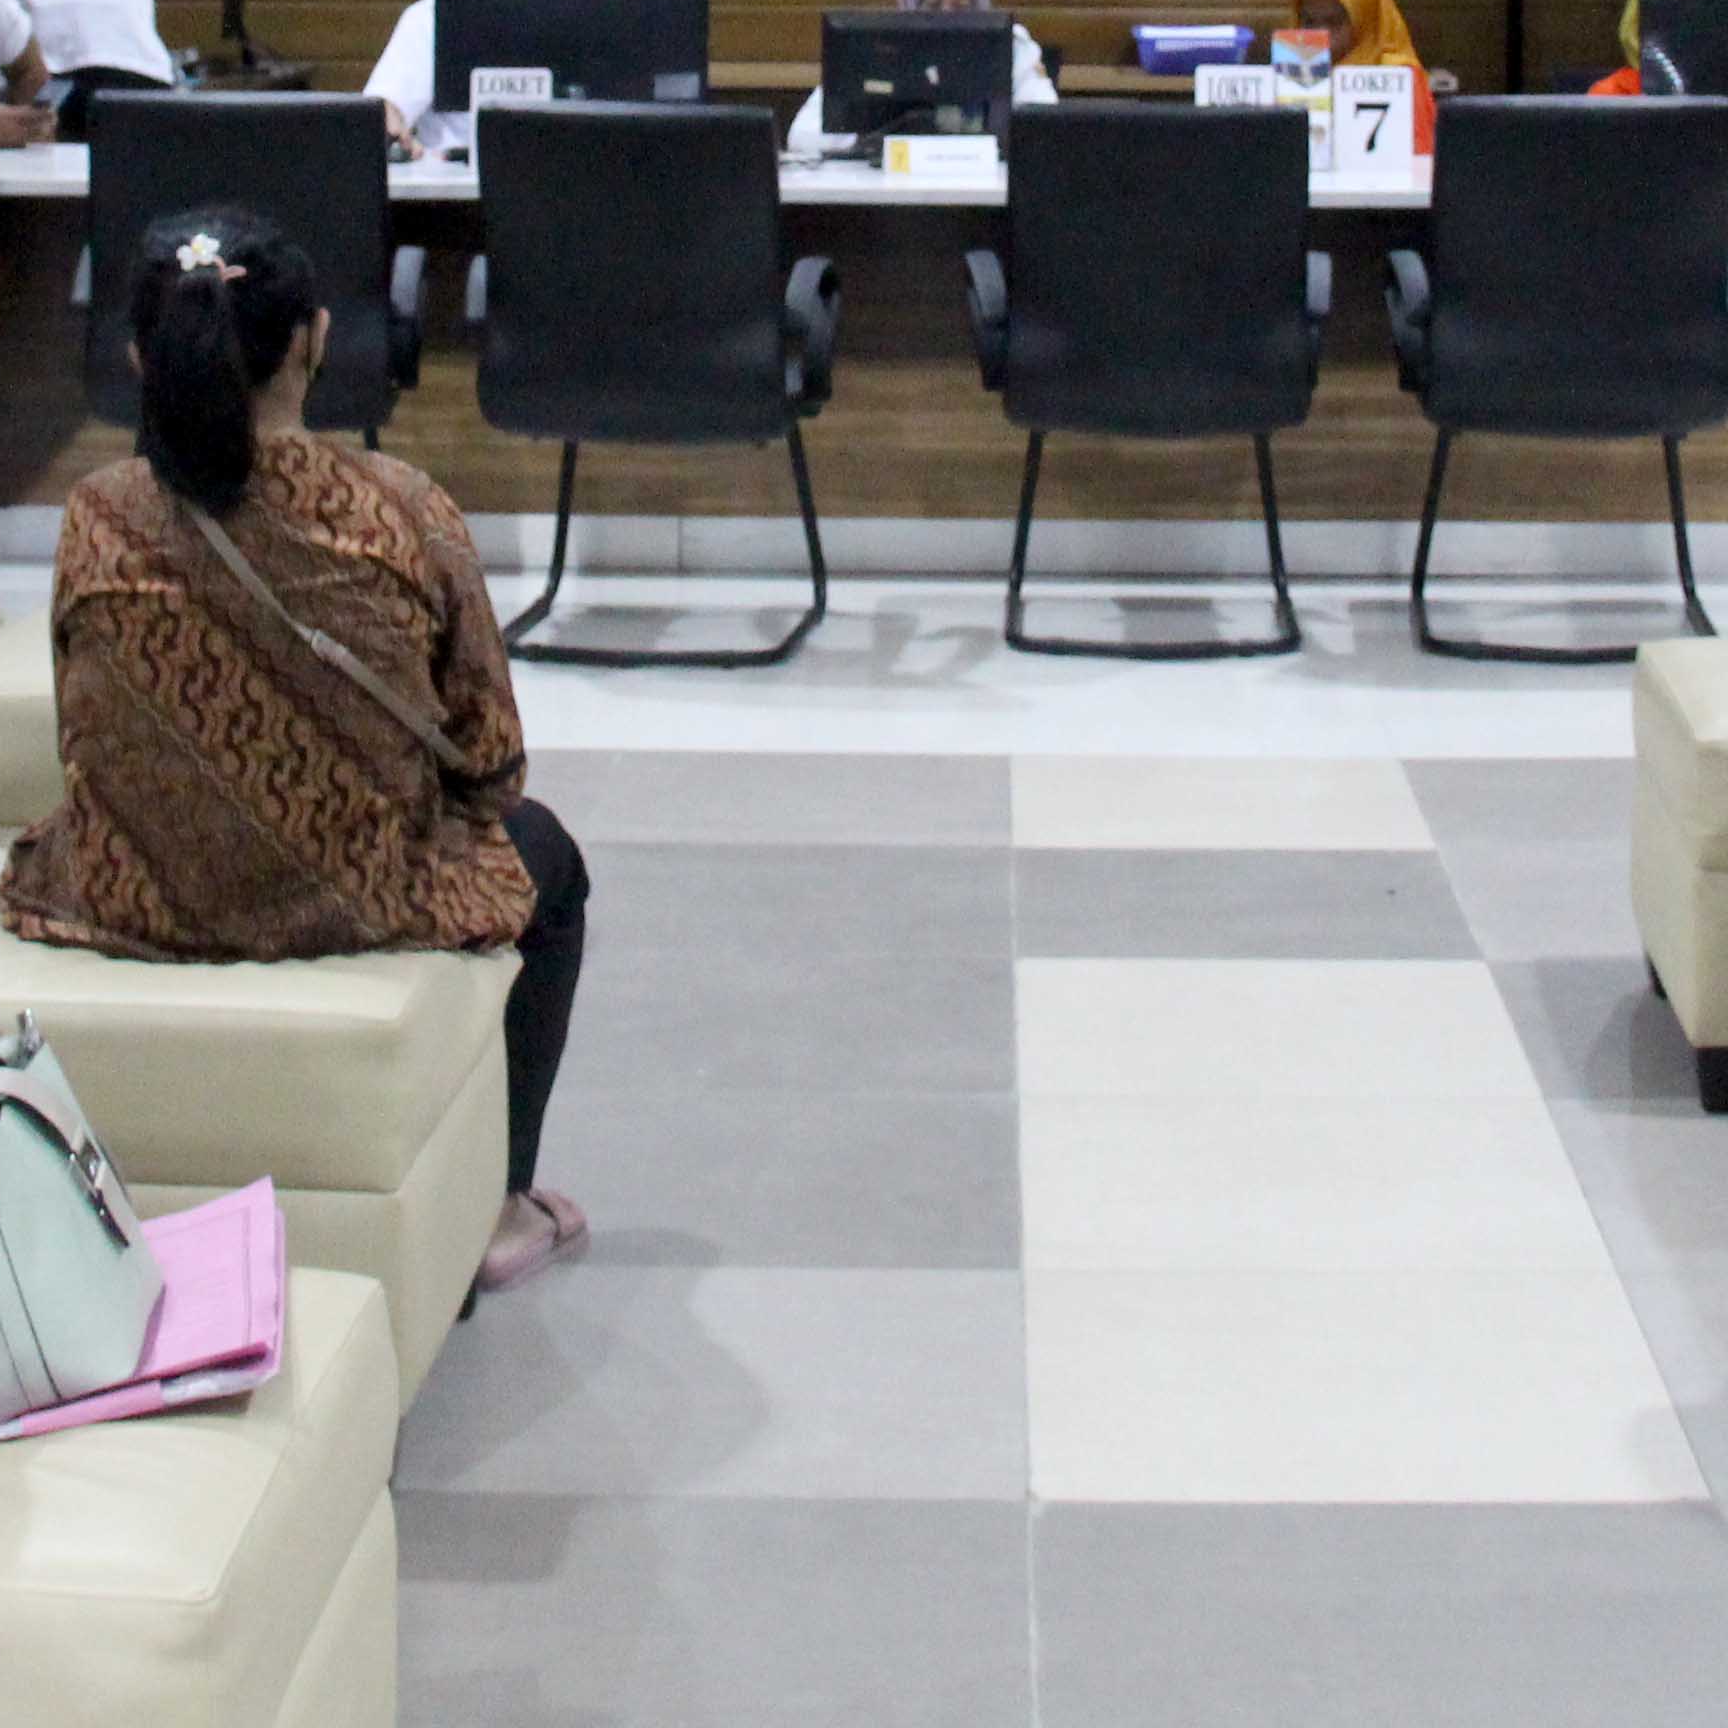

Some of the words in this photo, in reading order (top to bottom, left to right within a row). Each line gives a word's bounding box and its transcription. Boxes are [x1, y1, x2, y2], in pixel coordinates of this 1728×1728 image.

[478, 75, 546, 94] LOKET
[1207, 75, 1264, 104] LOKET
[1340, 73, 1406, 93] LOKET
[1354, 102, 1390, 153] 7
